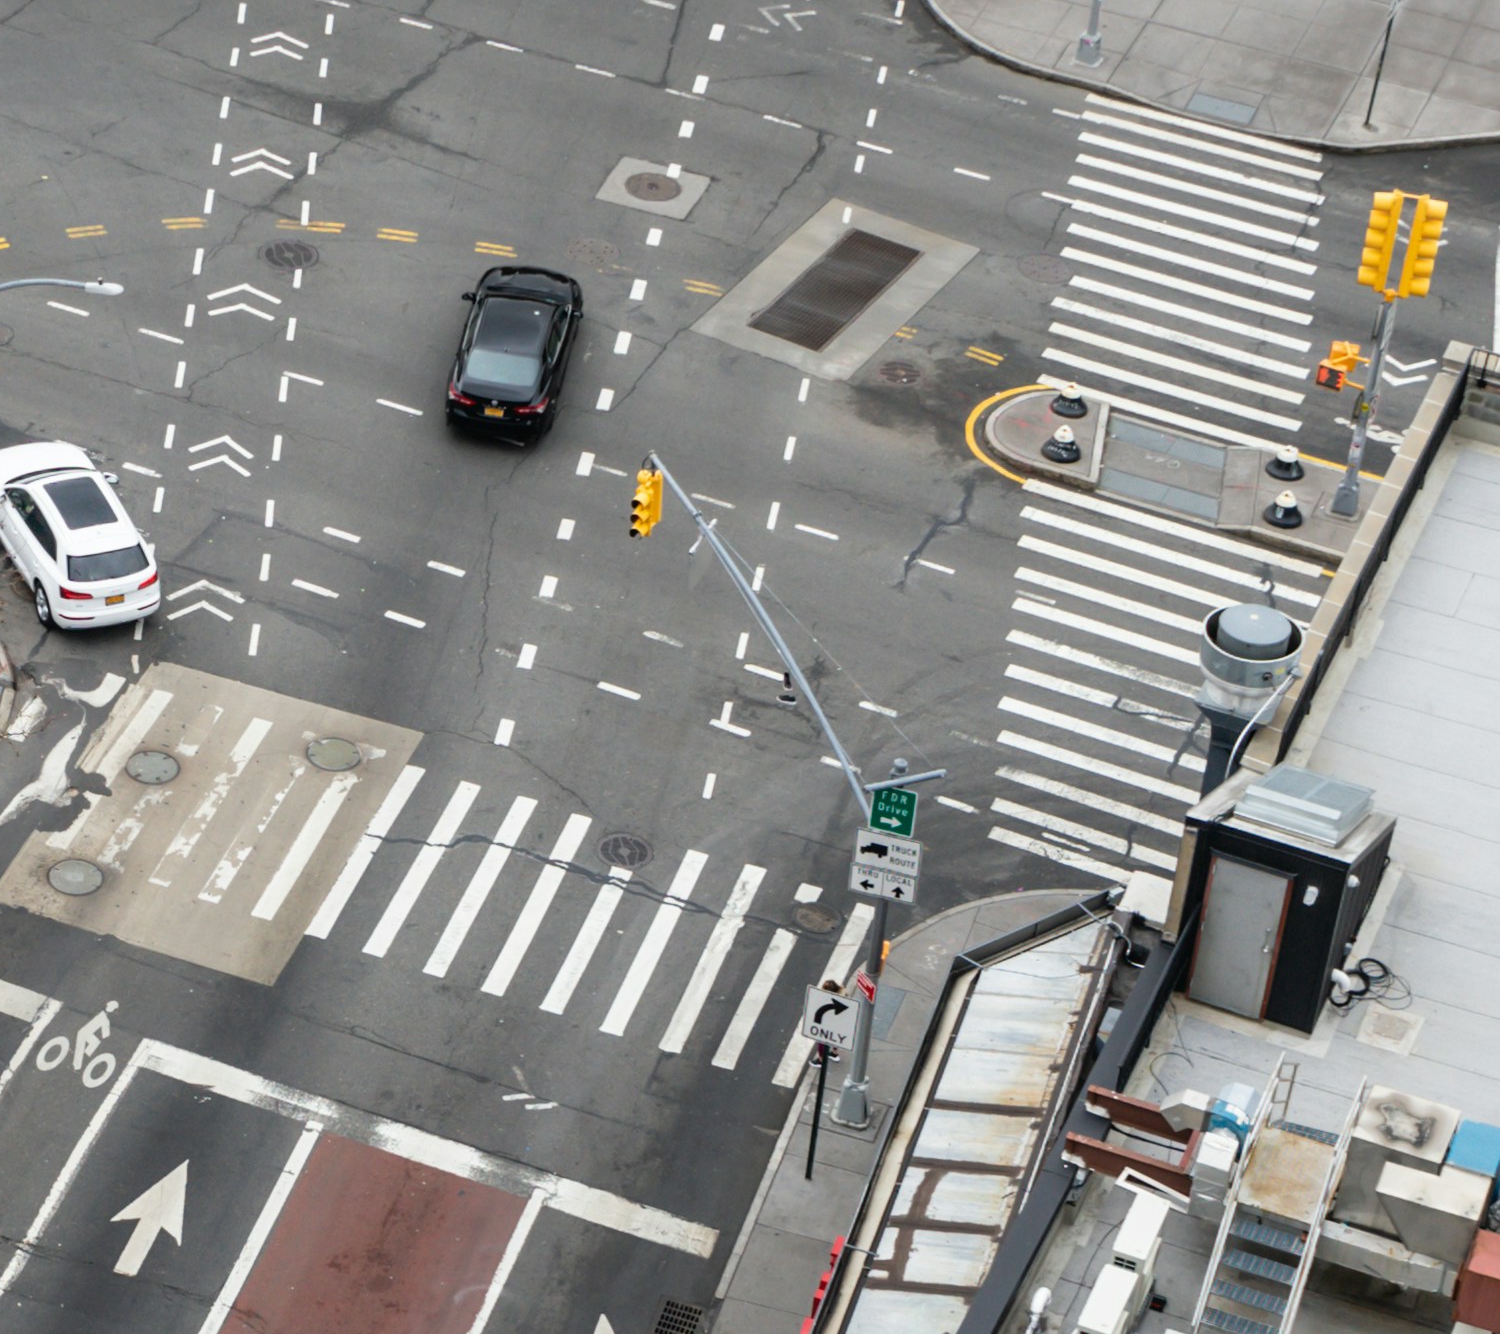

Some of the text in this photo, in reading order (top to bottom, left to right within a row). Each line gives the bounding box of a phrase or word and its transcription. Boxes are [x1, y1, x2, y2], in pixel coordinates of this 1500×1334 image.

[881, 790, 908, 805] FDR
[877, 802, 909, 817] Drive
[891, 844, 918, 857] TRUCK
[889, 856, 916, 870] ROUTE
[857, 867, 879, 879] THRU
[885, 874, 912, 887] LOCAL
[809, 1025, 847, 1044] ONLY
